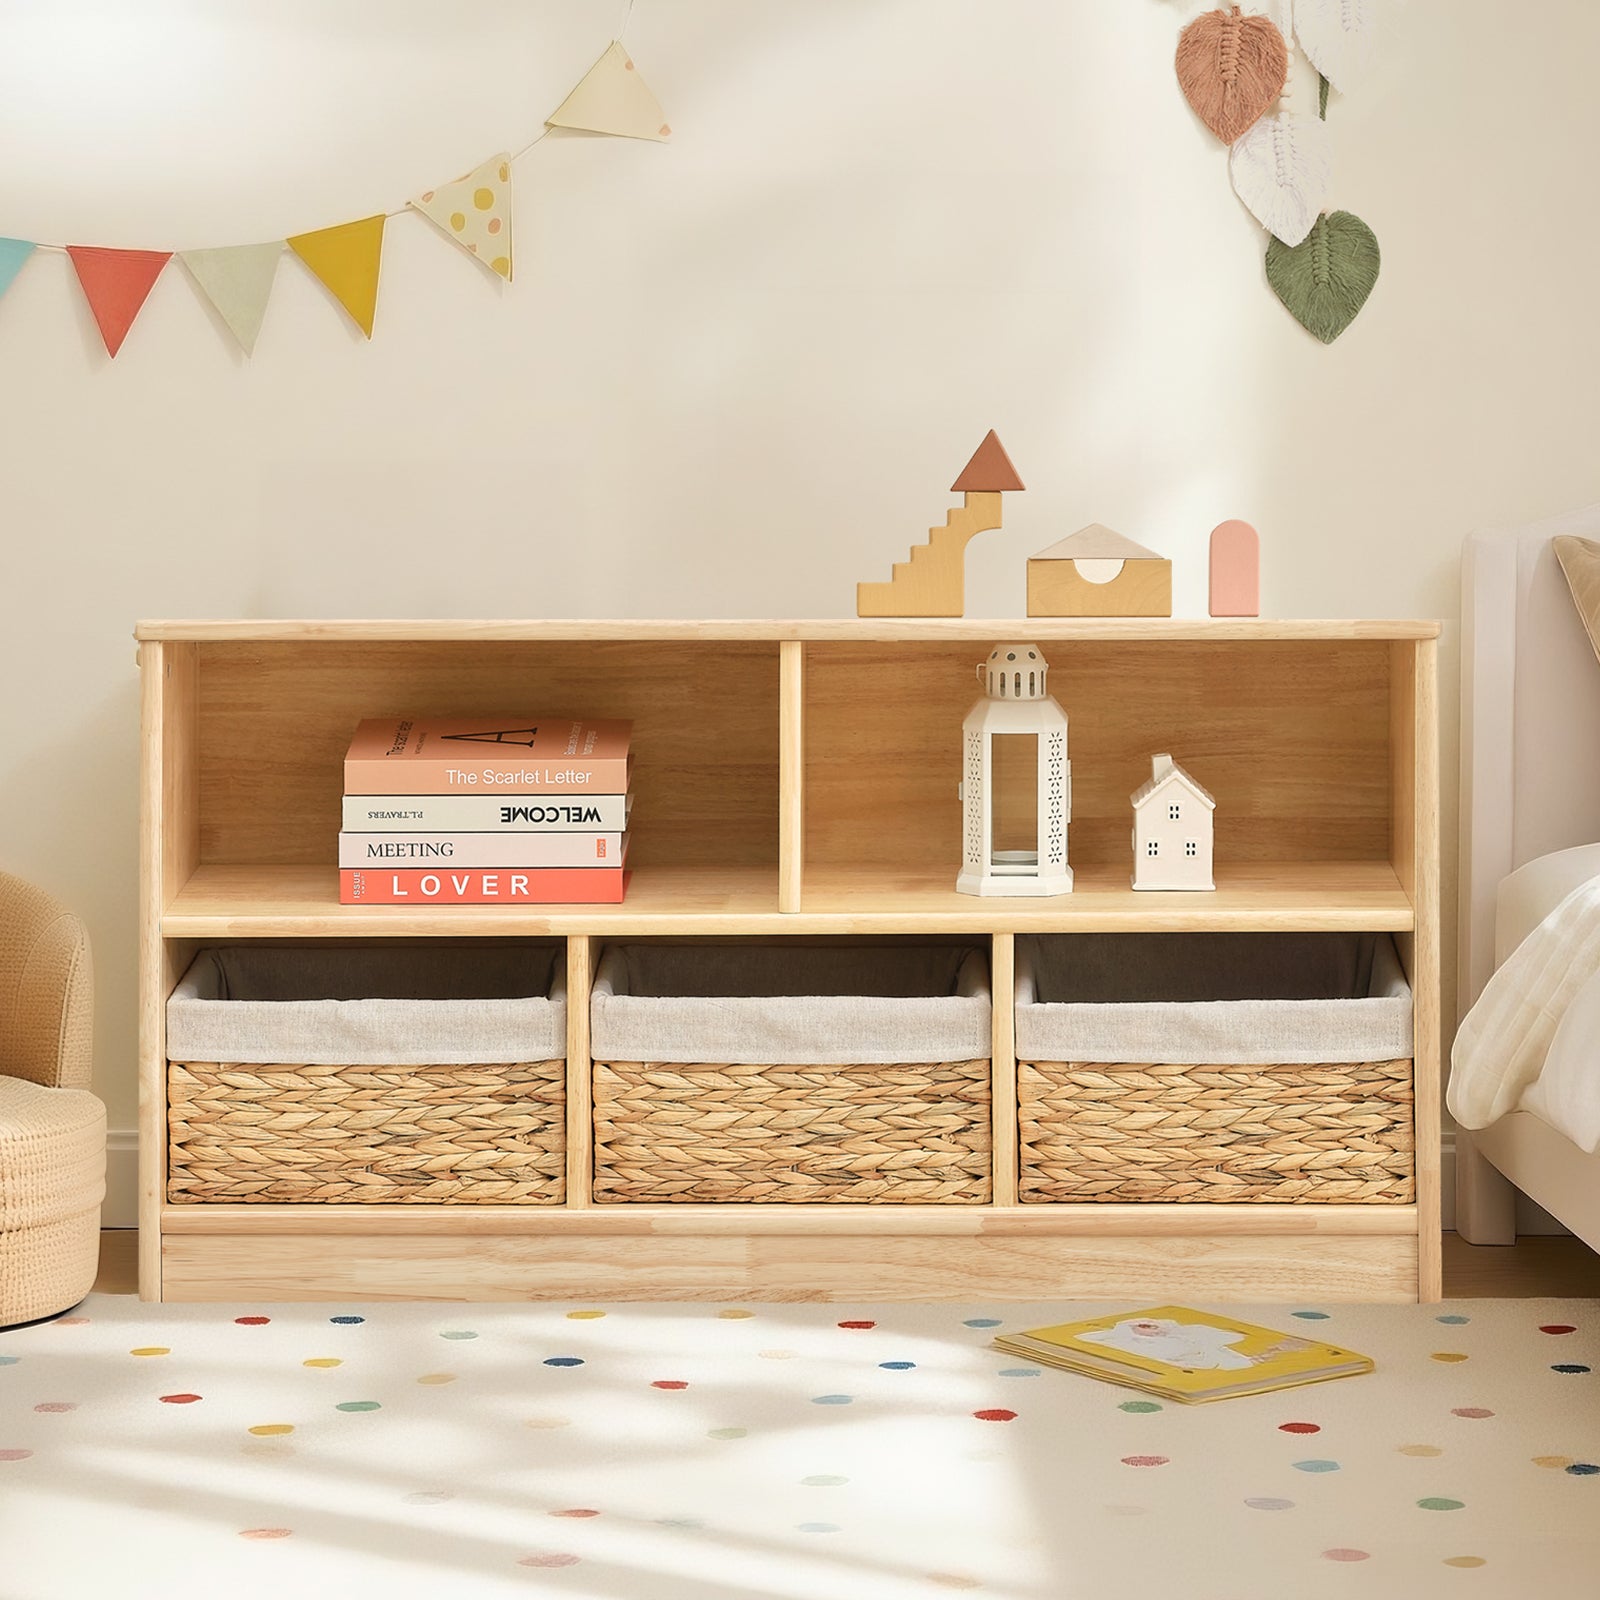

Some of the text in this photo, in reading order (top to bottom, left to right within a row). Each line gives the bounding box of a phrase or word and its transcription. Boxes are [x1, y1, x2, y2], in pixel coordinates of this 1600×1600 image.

[441, 727, 538, 748] A
[446, 769, 593, 785] The Scarlet Letter
[500, 807, 602, 823] WELCOME
[366, 842, 454, 859] MEETING
[353, 871, 361, 899] ISSUE
[392, 875, 530, 896] LOVER
